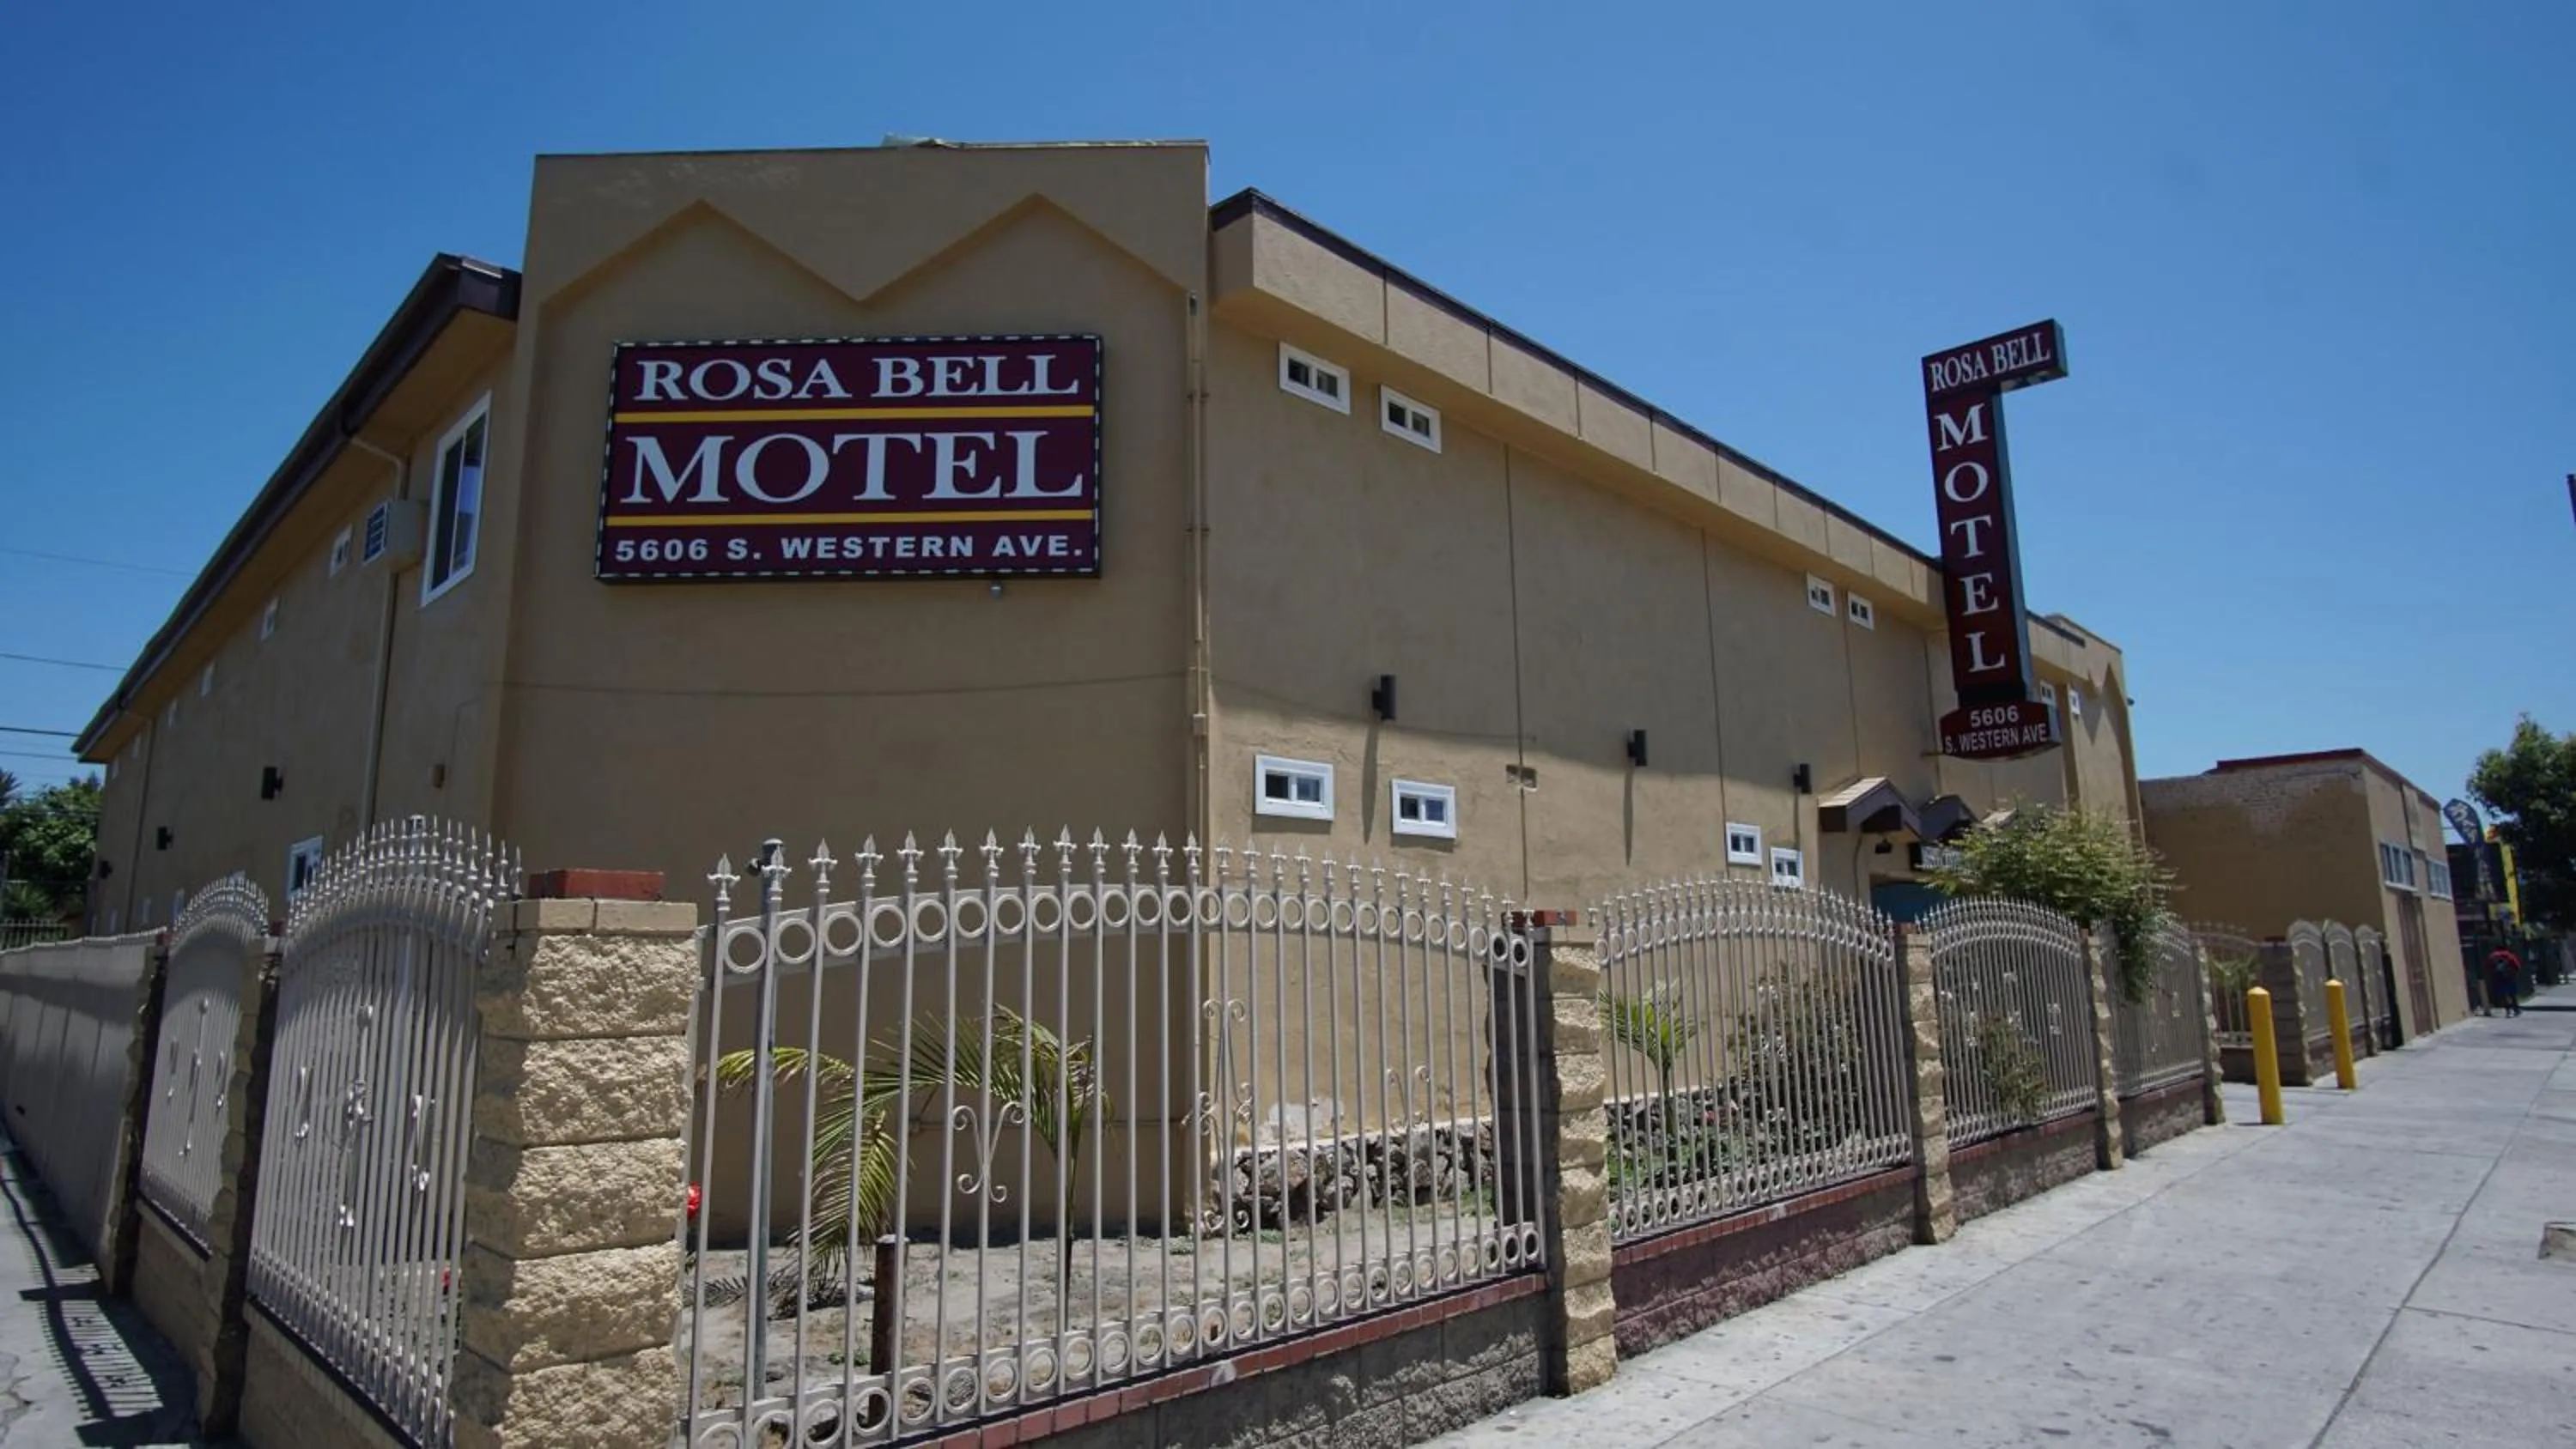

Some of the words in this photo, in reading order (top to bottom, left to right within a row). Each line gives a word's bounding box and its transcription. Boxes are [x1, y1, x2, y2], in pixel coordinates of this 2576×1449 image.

[634, 358, 852, 401] ROSA
[871, 355, 1078, 397] BELL
[1930, 350, 1990, 392] ROSA
[1991, 332, 2050, 374] BELL
[619, 430, 1083, 504] MOTEL
[616, 538, 709, 562] 5606
[727, 537, 762, 561] S.
[781, 536, 974, 560] WESTERN
[992, 534, 1083, 557] AVE.
[1935, 403, 2005, 673] MOTEL
[1971, 705, 2020, 728] 5606
[1945, 735, 1957, 754] S.
[1959, 727, 2020, 752] WESTERN
